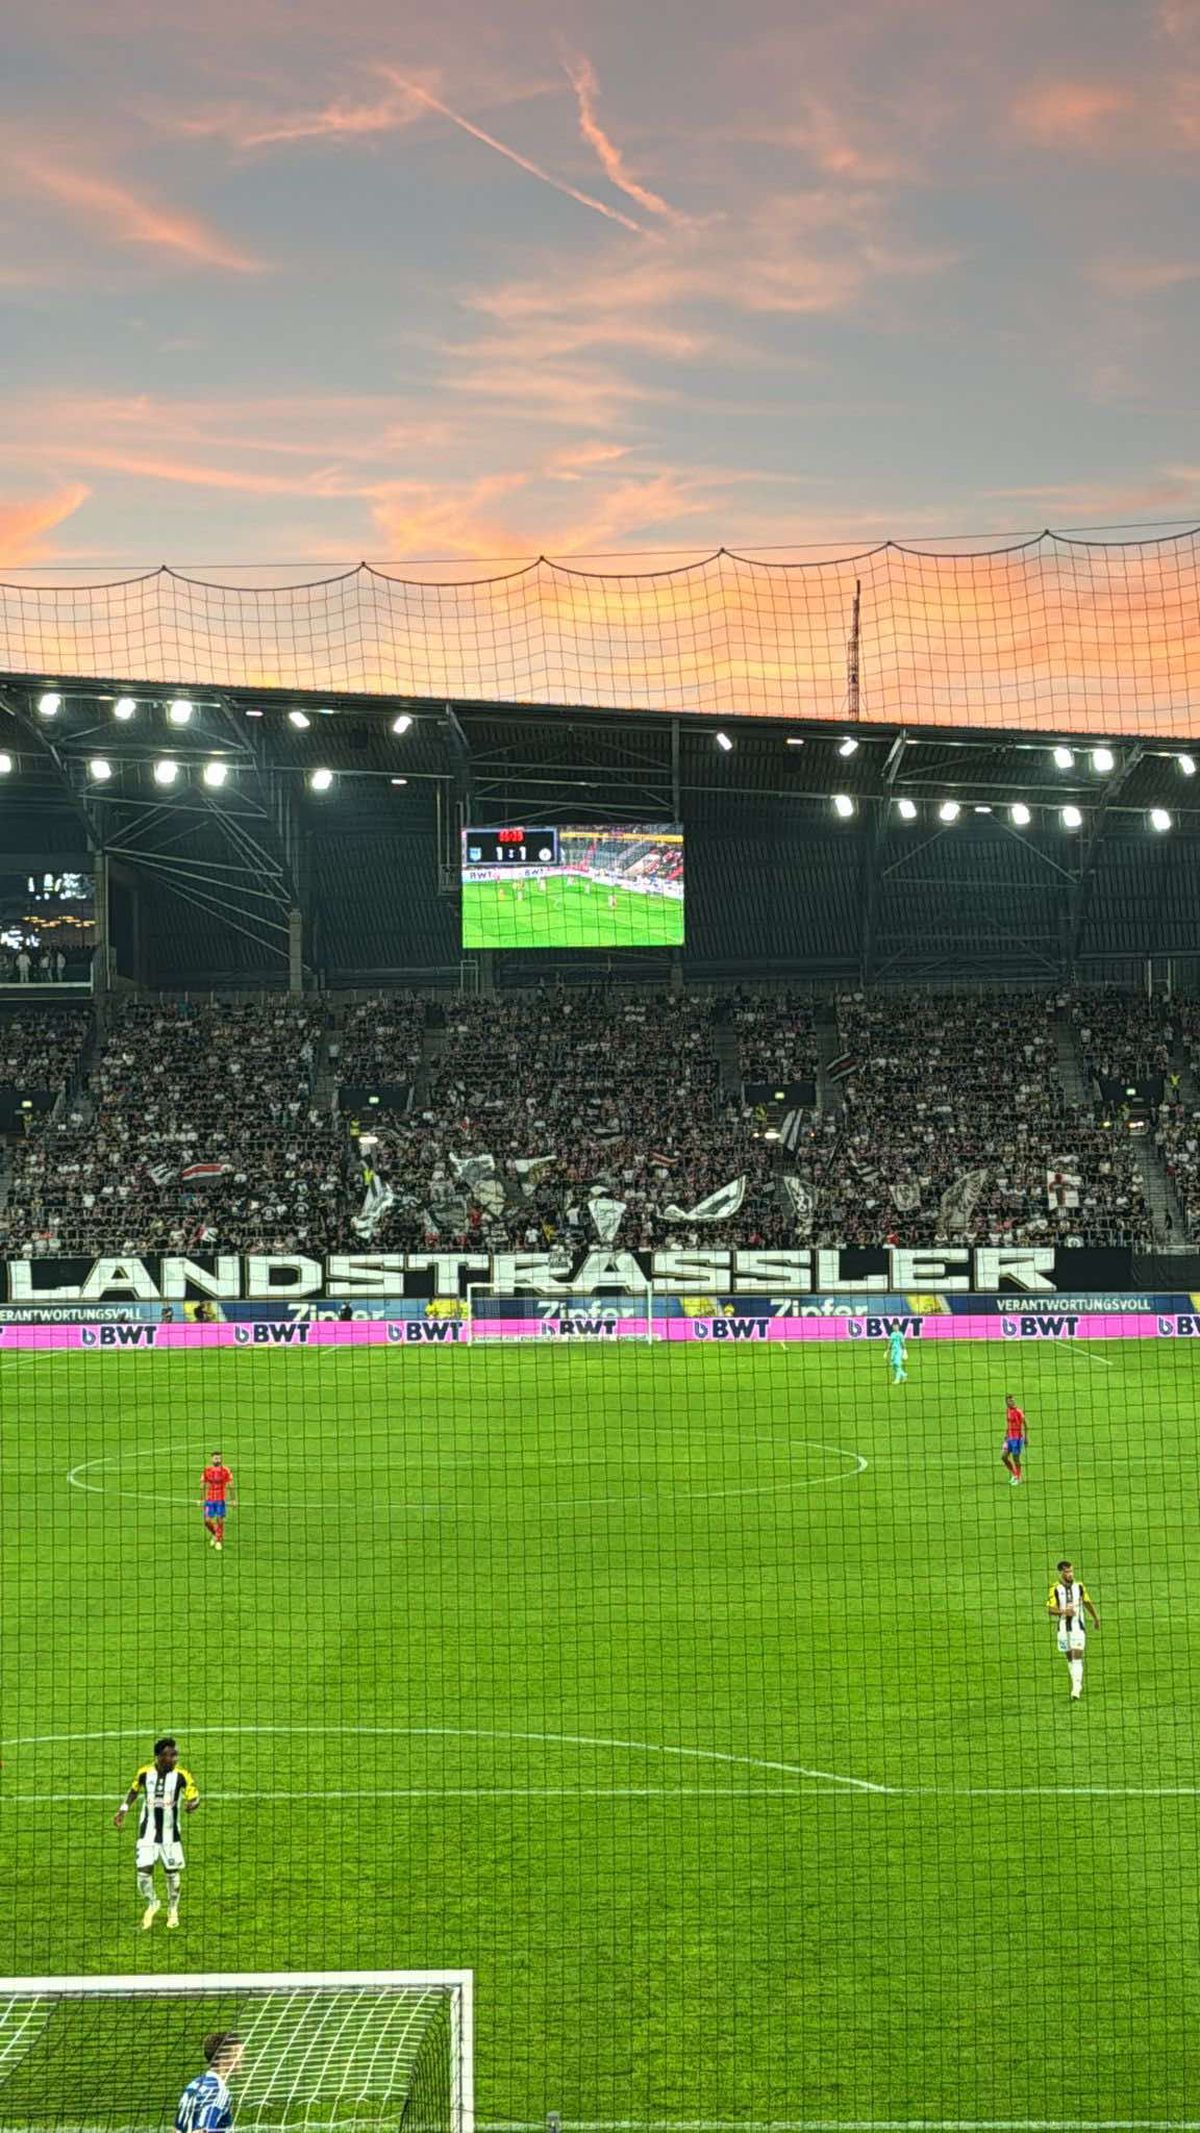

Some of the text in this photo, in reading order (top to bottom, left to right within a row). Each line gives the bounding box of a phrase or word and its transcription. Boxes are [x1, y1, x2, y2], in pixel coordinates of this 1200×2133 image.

[496, 847, 503, 860] 1
[519, 846, 526, 860] 1
[7, 1248, 1056, 1300] LANDSTRASSLER
[997, 1299, 1150, 1311] VERANTWORTUNGSVOLL
[101, 1326, 156, 1344] BWT
[254, 1324, 309, 1342] BWT
[407, 1322, 462, 1340] BWT
[712, 1319, 769, 1338] BWT
[1021, 1317, 1078, 1336] BWT
